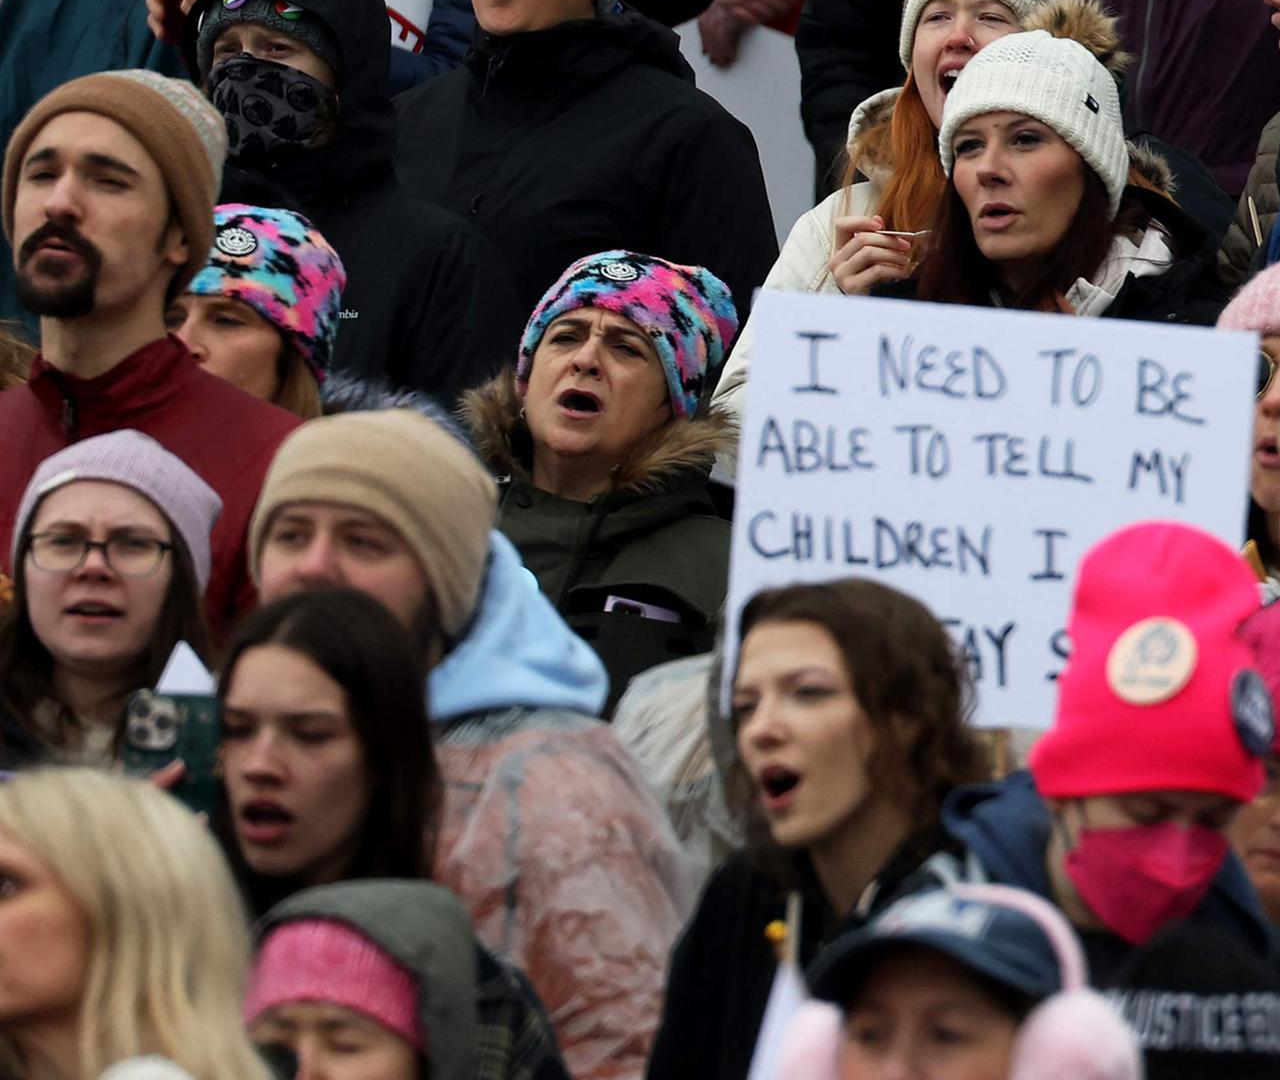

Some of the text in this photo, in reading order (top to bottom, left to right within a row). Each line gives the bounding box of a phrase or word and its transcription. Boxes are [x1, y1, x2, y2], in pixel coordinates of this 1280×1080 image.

[792, 331, 1208, 427] I NEED TO BE
[755, 415, 1193, 505] ABLE TO TELL MY
[747, 510, 1070, 583] CHILDREN I
